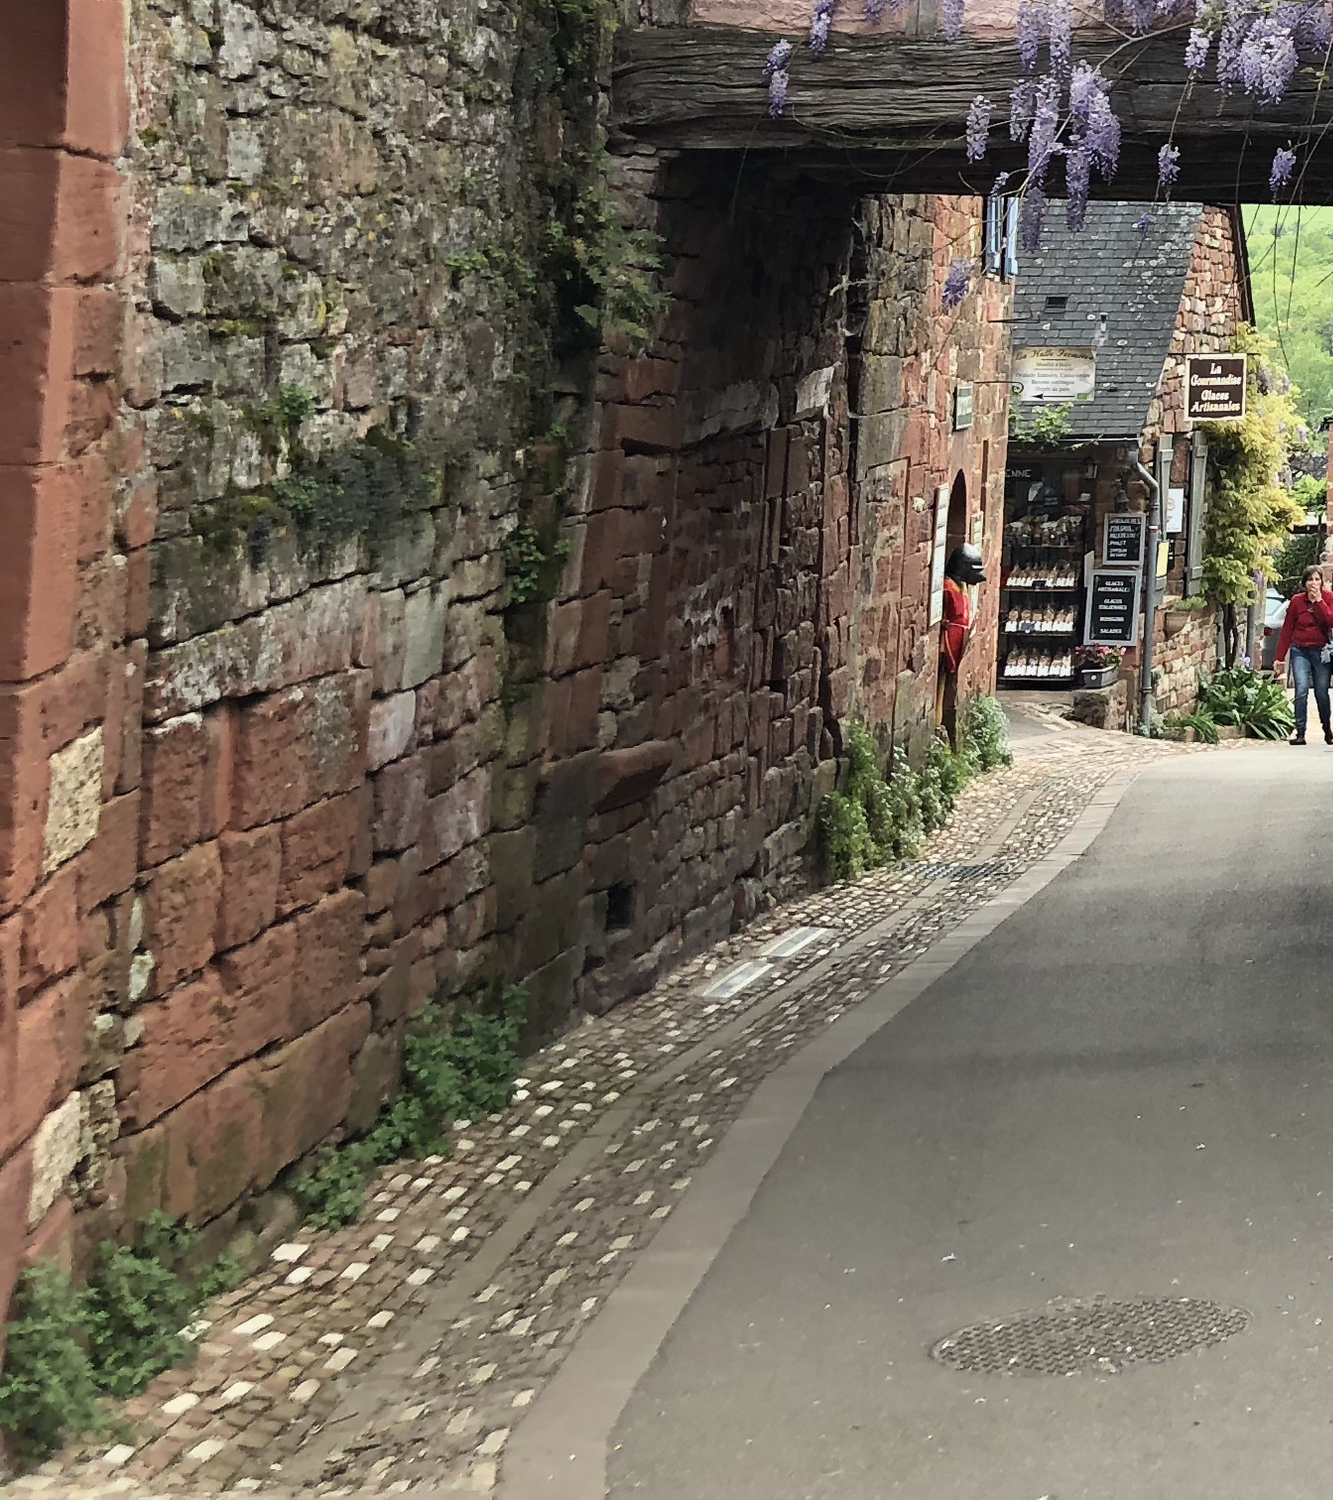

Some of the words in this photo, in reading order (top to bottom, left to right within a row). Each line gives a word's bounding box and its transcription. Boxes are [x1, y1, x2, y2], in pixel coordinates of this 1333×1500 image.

[1210, 362, 1222, 375] La
[1190, 373, 1242, 386] Gourmandise
[1201, 389, 1230, 401] Glaces
[1190, 400, 1241, 412] Artisanales
